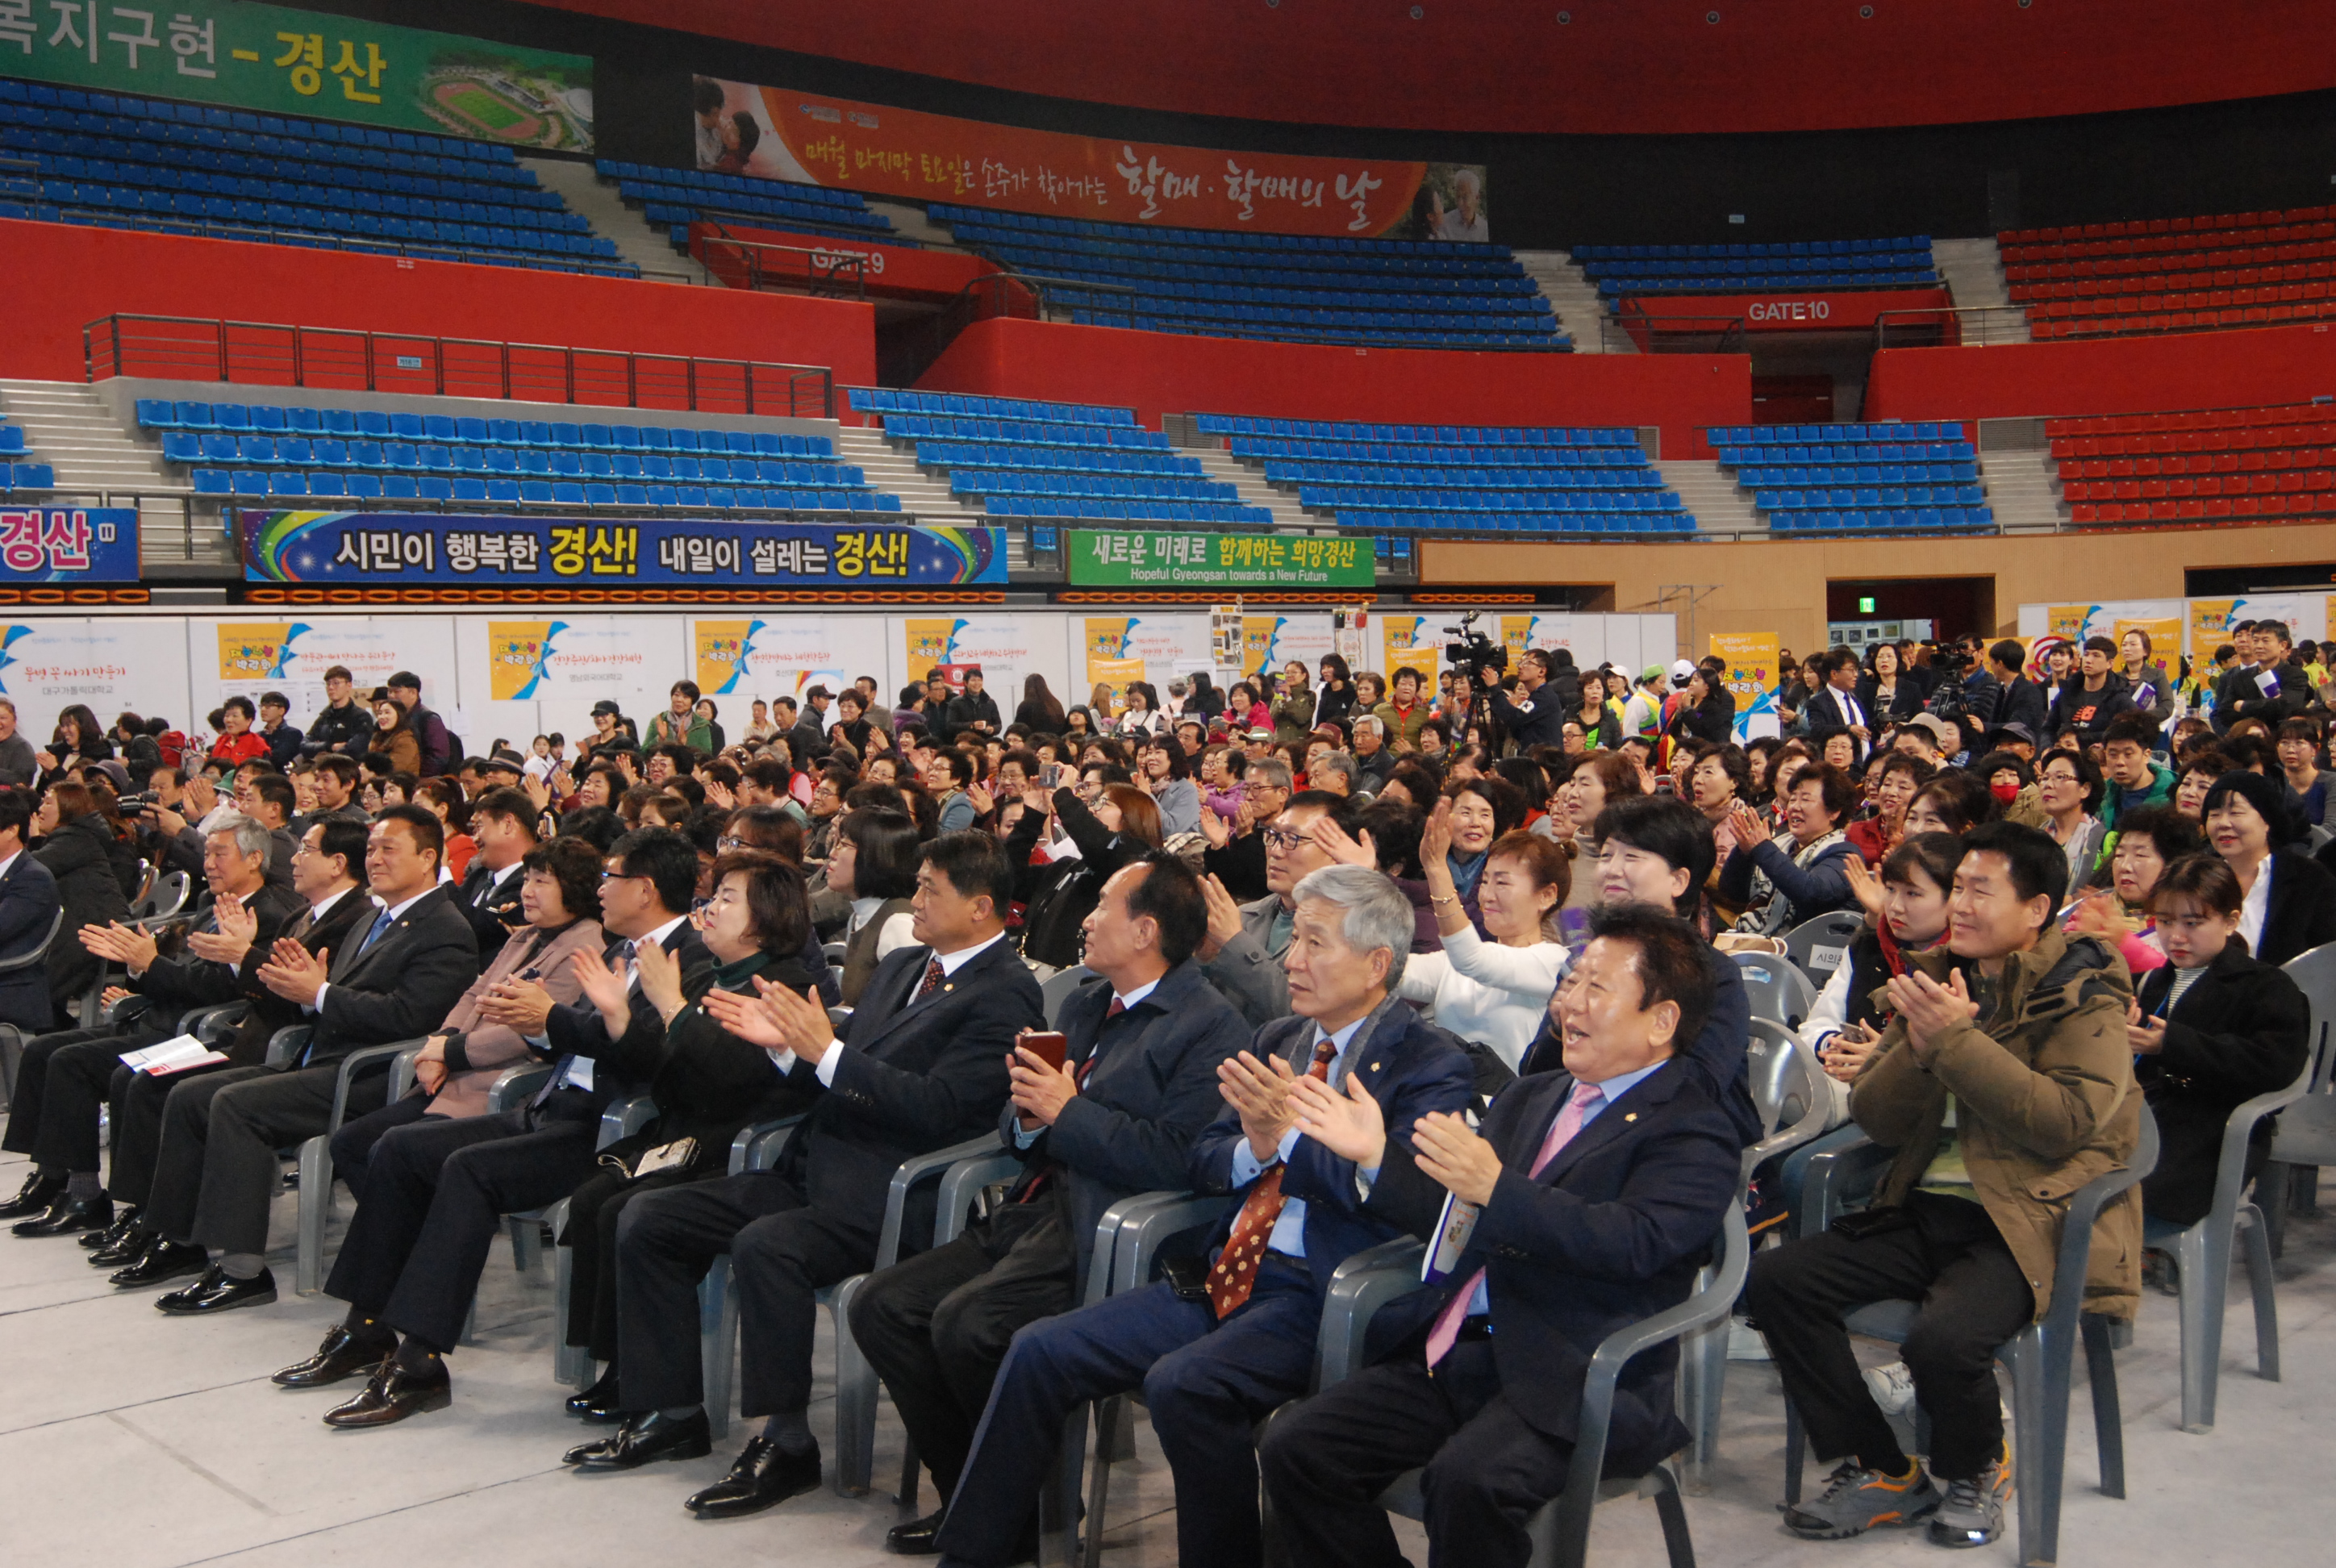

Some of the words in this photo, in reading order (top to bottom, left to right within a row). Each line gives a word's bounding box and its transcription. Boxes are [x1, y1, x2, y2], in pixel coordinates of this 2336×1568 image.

[273, 31, 388, 105] 경산
[807, 136, 849, 180] 매월
[855, 148, 912, 181] 마지막
[920, 152, 975, 195] 토요일은
[982, 157, 1028, 198] 손주가
[1037, 165, 1108, 205] 찾아가는
[1116, 145, 1200, 219] 할매
[1335, 170, 1383, 231] 날
[811, 247, 870, 273] GATE
[871, 252, 885, 274] 9
[1749, 302, 1806, 320] GATE
[1808, 301, 1829, 319] 10
[336, 531, 436, 571] 시민이
[445, 532, 540, 571] 행복한
[549, 527, 638, 575] 경산!
[660, 536, 740, 573] 내일이
[750, 539, 828, 573] 설레는
[833, 532, 909, 576] 경산!
[1091, 534, 1147, 565] 새로운
[1154, 536, 1207, 564] 미래로
[1219, 537, 1285, 566] 함께하는
[1291, 539, 1357, 568] 희망경산
[1131, 567, 1170, 582] Hopeful
[1172, 568, 1227, 582] Gyeongsan
[1229, 569, 1268, 581] towards
[1269, 572, 1276, 582] a
[1277, 569, 1296, 581] New
[1298, 569, 1329, 582] Future
[229, 644, 273, 658] 재능나눔
[236, 658, 272, 671] 박람회
[24, 666, 48, 682] 물병
[93, 664, 127, 680] 만들기
[569, 673, 624, 683] 영남외국어대학교
[1722, 668, 1767, 681] 재능나눔
[42, 686, 114, 696] 대구가톨릭대학교
[1727, 681, 1764, 694] 박람회
